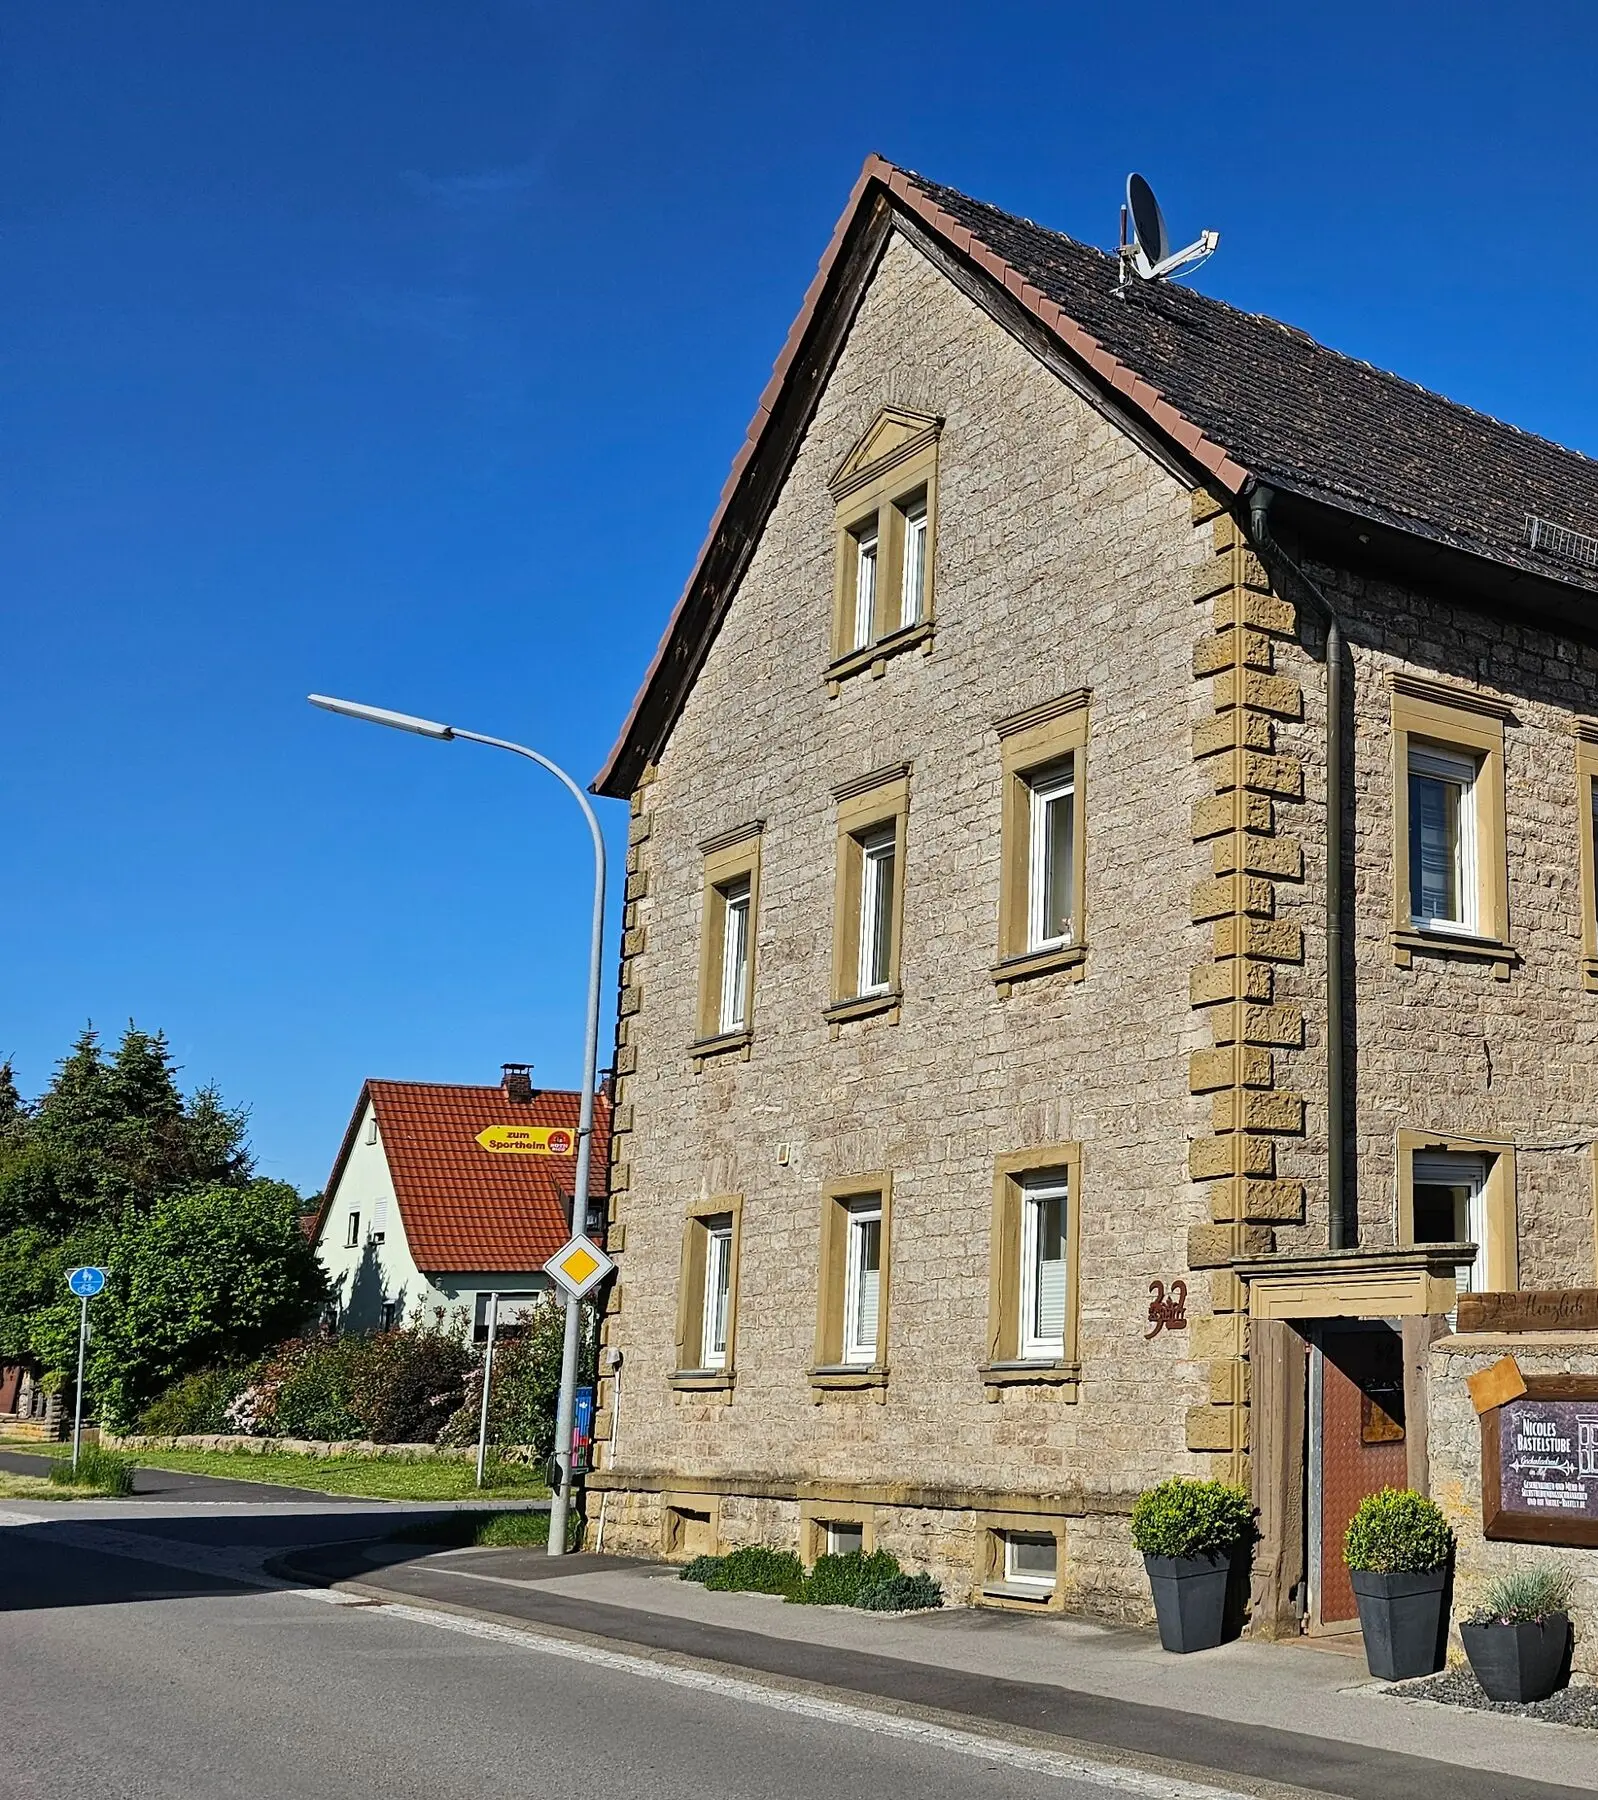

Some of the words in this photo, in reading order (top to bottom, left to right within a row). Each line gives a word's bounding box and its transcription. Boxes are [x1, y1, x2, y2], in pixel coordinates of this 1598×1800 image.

[506, 1131, 530, 1139] zum
[489, 1140, 546, 1150] Sportheim
[1524, 1293, 1584, 1324] Herzlich
